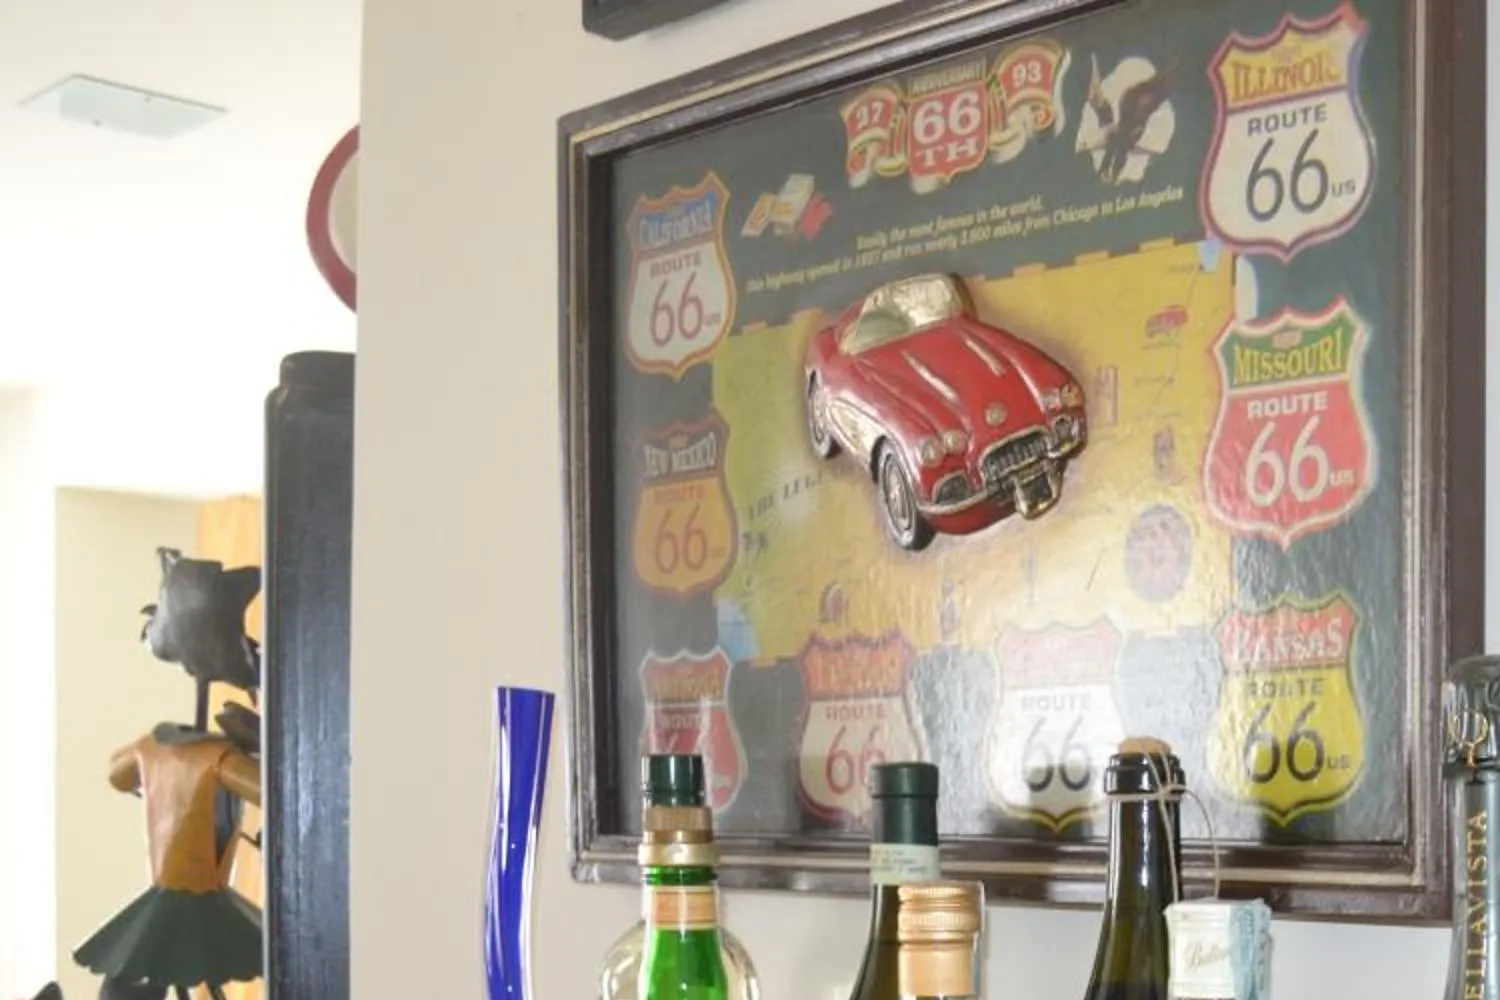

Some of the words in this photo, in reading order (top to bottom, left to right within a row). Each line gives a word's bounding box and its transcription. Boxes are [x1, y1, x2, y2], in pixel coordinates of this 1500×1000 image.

[1011, 60, 1043, 87] 93
[913, 90, 981, 145] 66
[1247, 103, 1328, 137] ROUTE
[915, 137, 978, 167] TH
[1246, 128, 1329, 222] 66
[1331, 179, 1356, 197] US
[1052, 203, 1099, 226] Chicago
[651, 251, 702, 277] ROUTE
[651, 271, 704, 348] 66
[1233, 326, 1344, 386] MISSOURI
[1247, 390, 1329, 419] ROUTE
[1245, 413, 1330, 507] 66
[655, 503, 707, 574] 66
[1233, 616, 1344, 665] KANSAS
[1021, 692, 1092, 712] ROUTE
[1249, 677, 1326, 699] ROUTE
[826, 702, 888, 721] ROUTE
[1021, 714, 1092, 792] 66
[1243, 701, 1326, 784] 66
